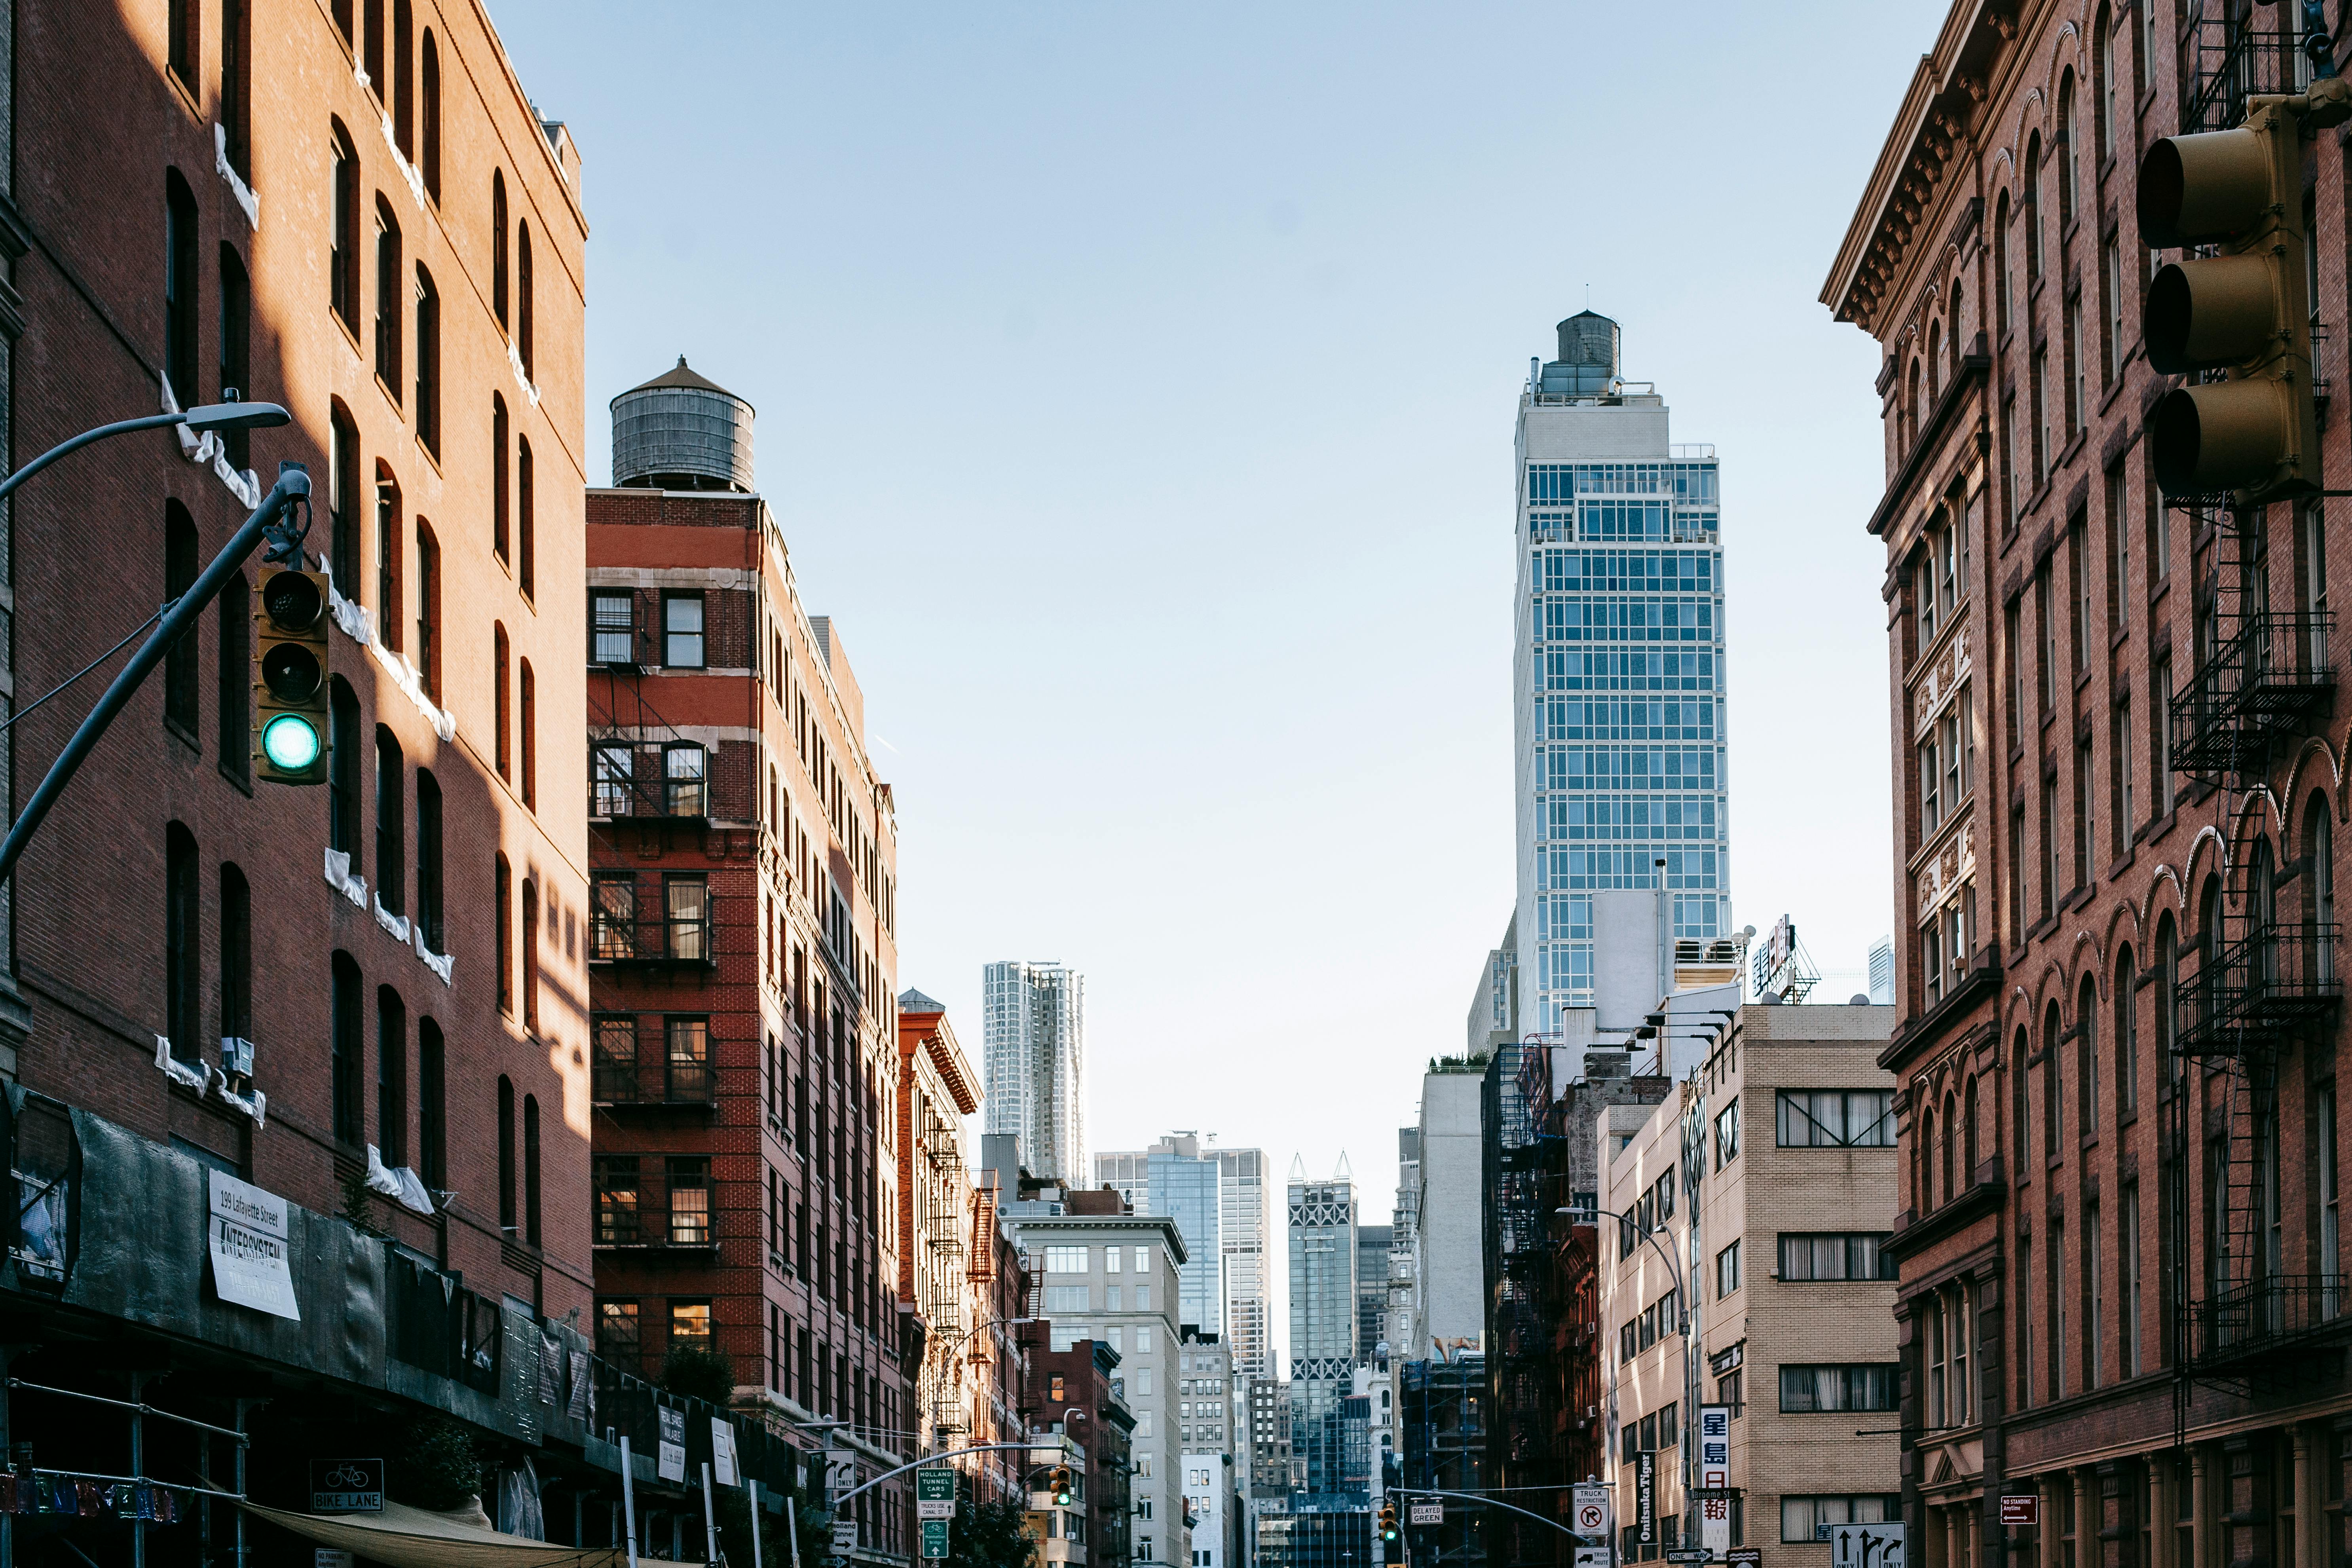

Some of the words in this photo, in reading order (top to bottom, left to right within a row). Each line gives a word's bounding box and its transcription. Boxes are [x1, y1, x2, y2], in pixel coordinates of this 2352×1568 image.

[220, 1190, 232, 1209] 199
[233, 1194, 260, 1220] Lafayette
[260, 1205, 278, 1228] Street
[1640, 1454, 1652, 1488] Tiger
[316, 1494, 342, 1507] BIKE
[348, 1494, 379, 1507] LANE
[1640, 1487, 1650, 1541] Onitsuka
[1818, 1525, 1831, 1539] 星
